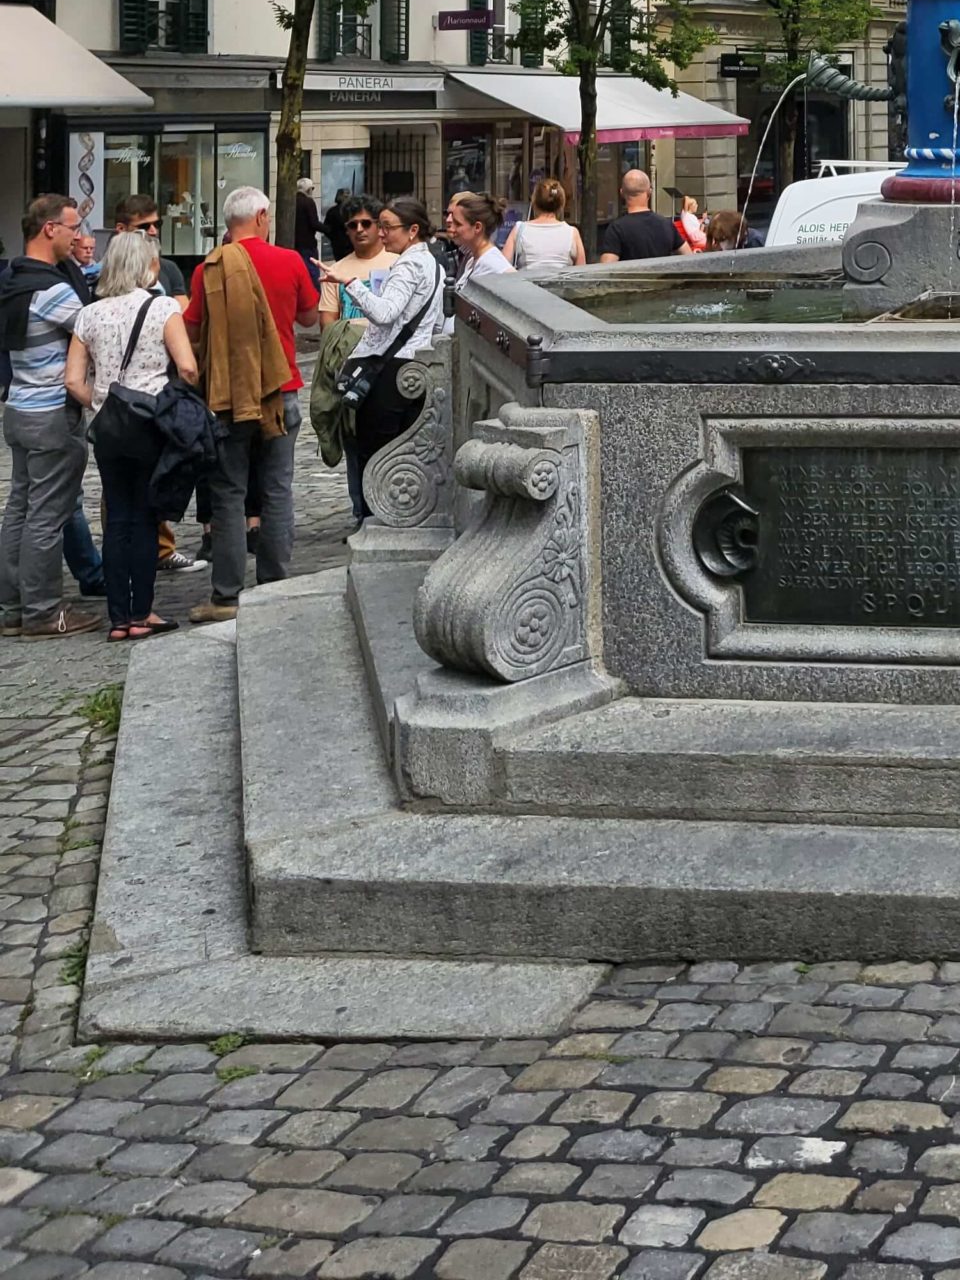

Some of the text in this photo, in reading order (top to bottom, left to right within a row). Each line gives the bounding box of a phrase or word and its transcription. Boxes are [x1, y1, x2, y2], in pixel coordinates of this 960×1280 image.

[338, 77, 394, 89] PANERAI
[329, 91, 382, 103] PANERAI
[798, 223, 826, 233] ALOIS
[803, 513, 830, 526] DER
[856, 546, 942, 559] TRADITION
[815, 561, 851, 574] WER
